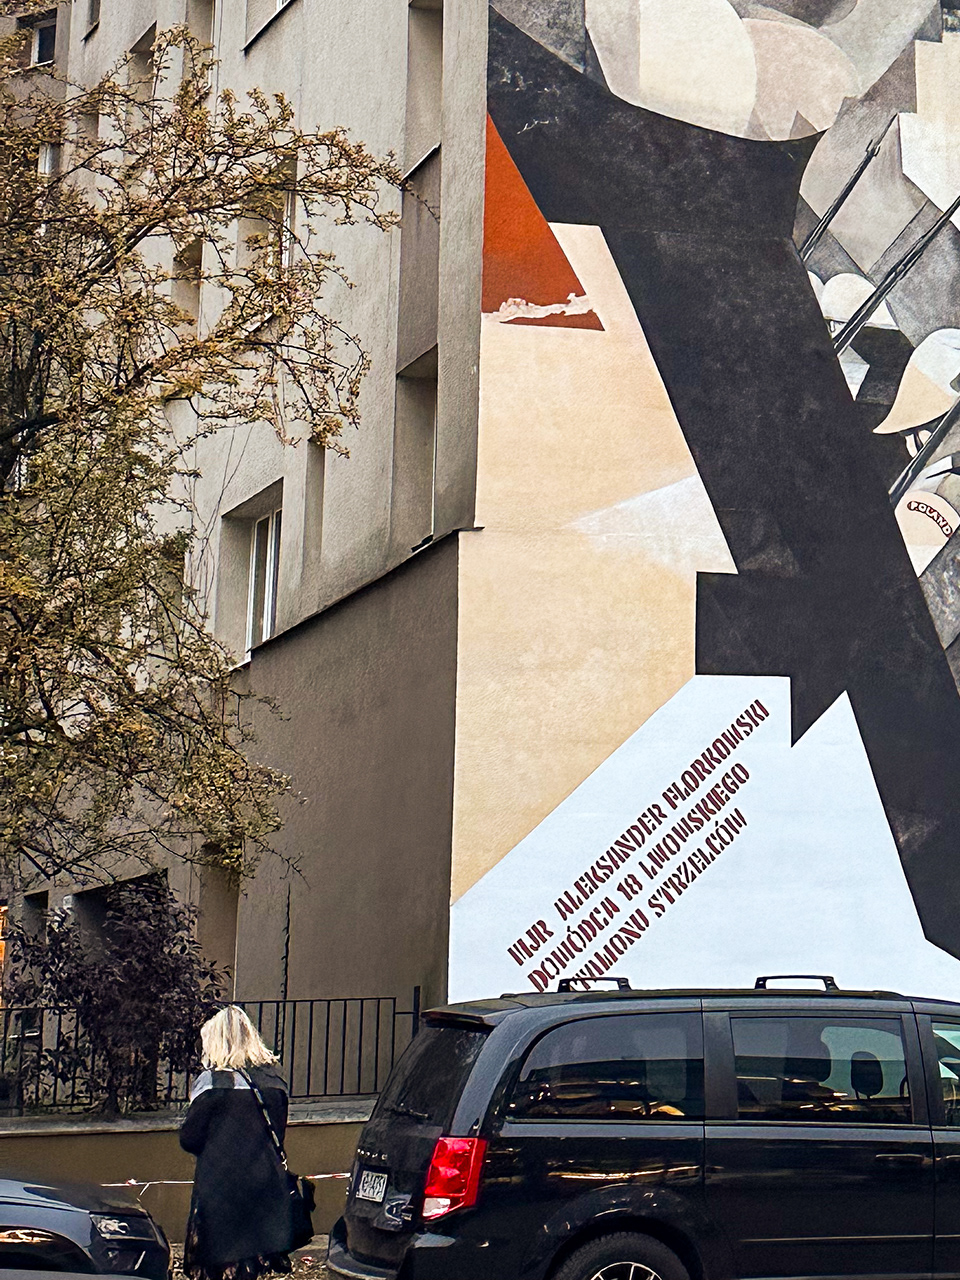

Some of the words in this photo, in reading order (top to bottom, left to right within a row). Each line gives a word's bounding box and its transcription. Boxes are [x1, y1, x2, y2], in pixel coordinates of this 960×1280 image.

[910, 501, 952, 536] POLAND
[507, 920, 554, 966] MJR
[554, 804, 668, 921] ALEKSANDER
[662, 700, 770, 810] FLORKOWSKI
[527, 897, 620, 993] DOWÓDCA
[617, 874, 643, 901] 18
[639, 763, 750, 880] LWOWSKIEGO
[648, 807, 748, 919] STRZELCÓW
